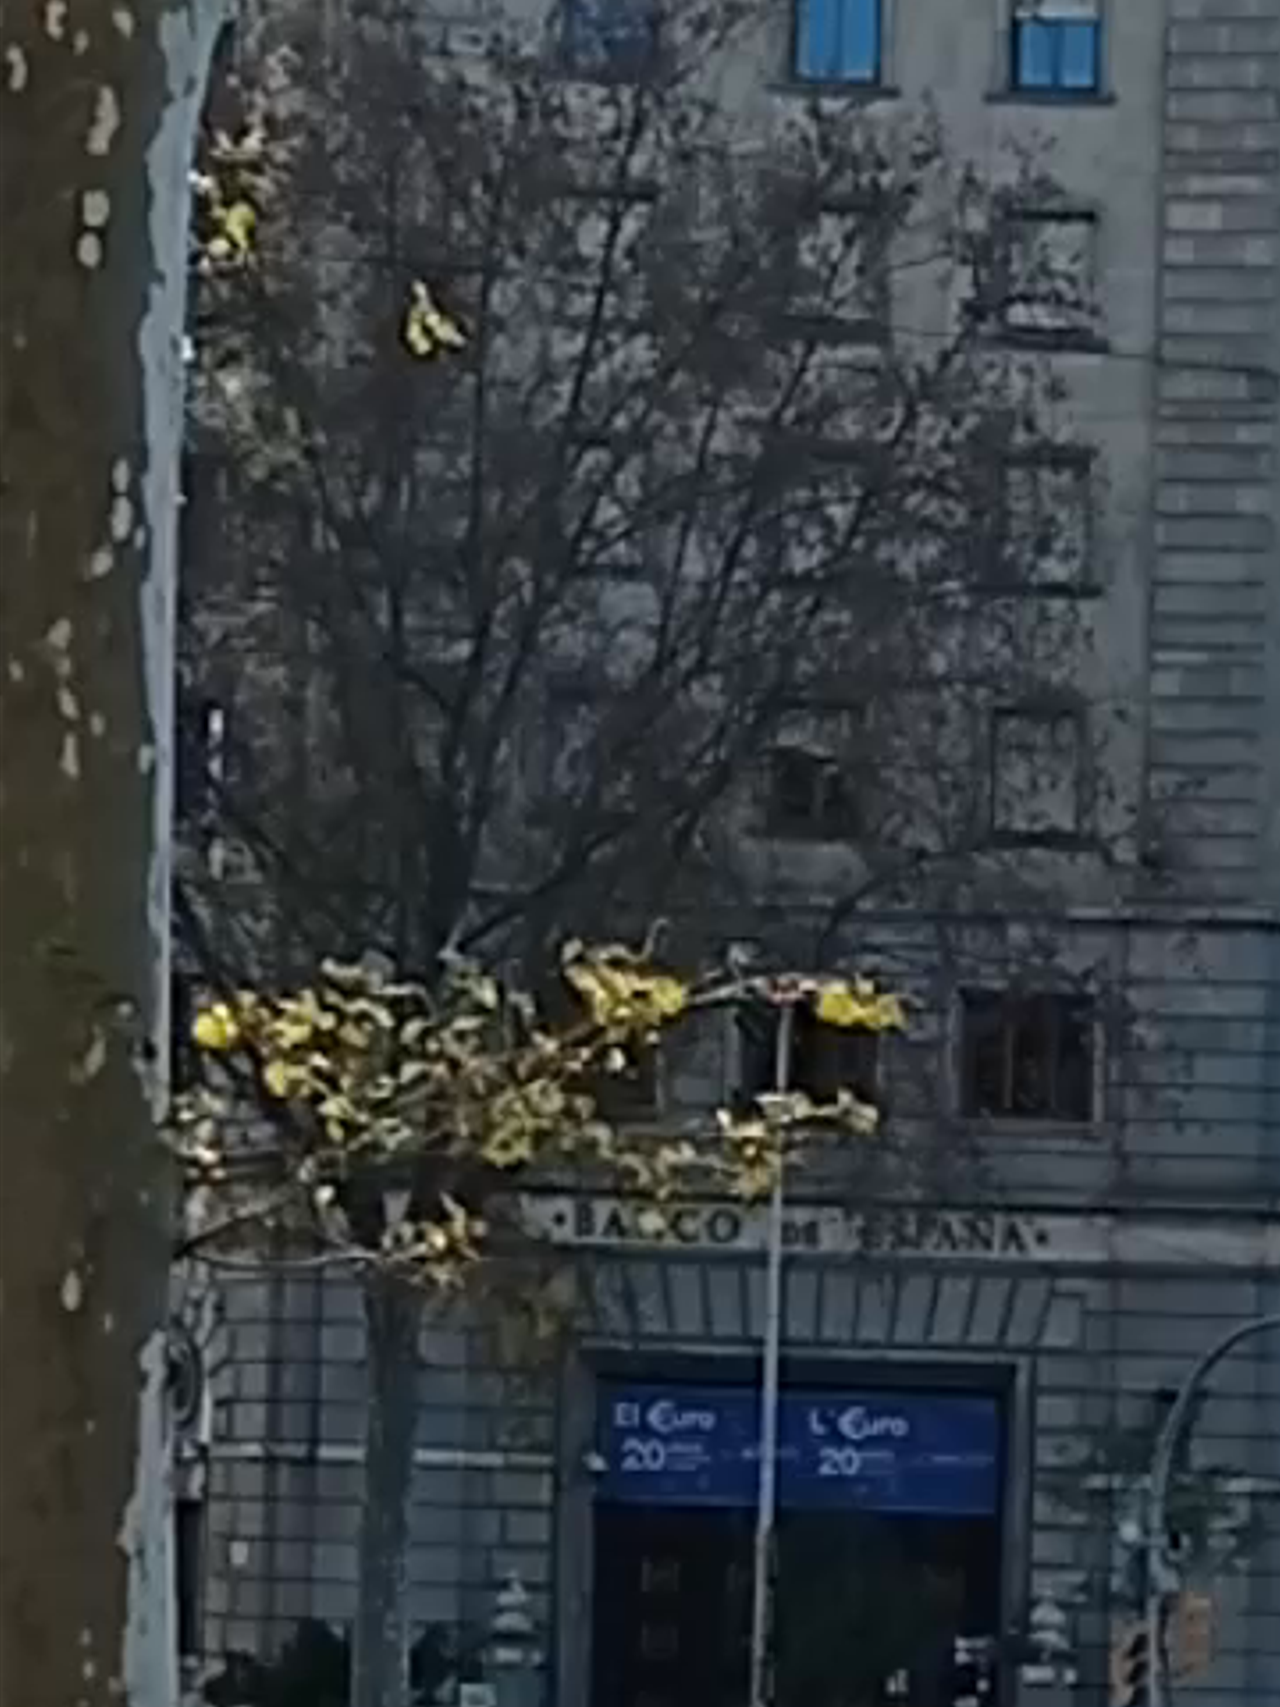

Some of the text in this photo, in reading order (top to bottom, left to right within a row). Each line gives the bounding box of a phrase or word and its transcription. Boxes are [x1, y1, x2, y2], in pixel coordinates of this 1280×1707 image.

[574, 1198, 741, 1244] BACO
[620, 1438, 666, 1472] 20
[818, 1448, 862, 1476] 20
